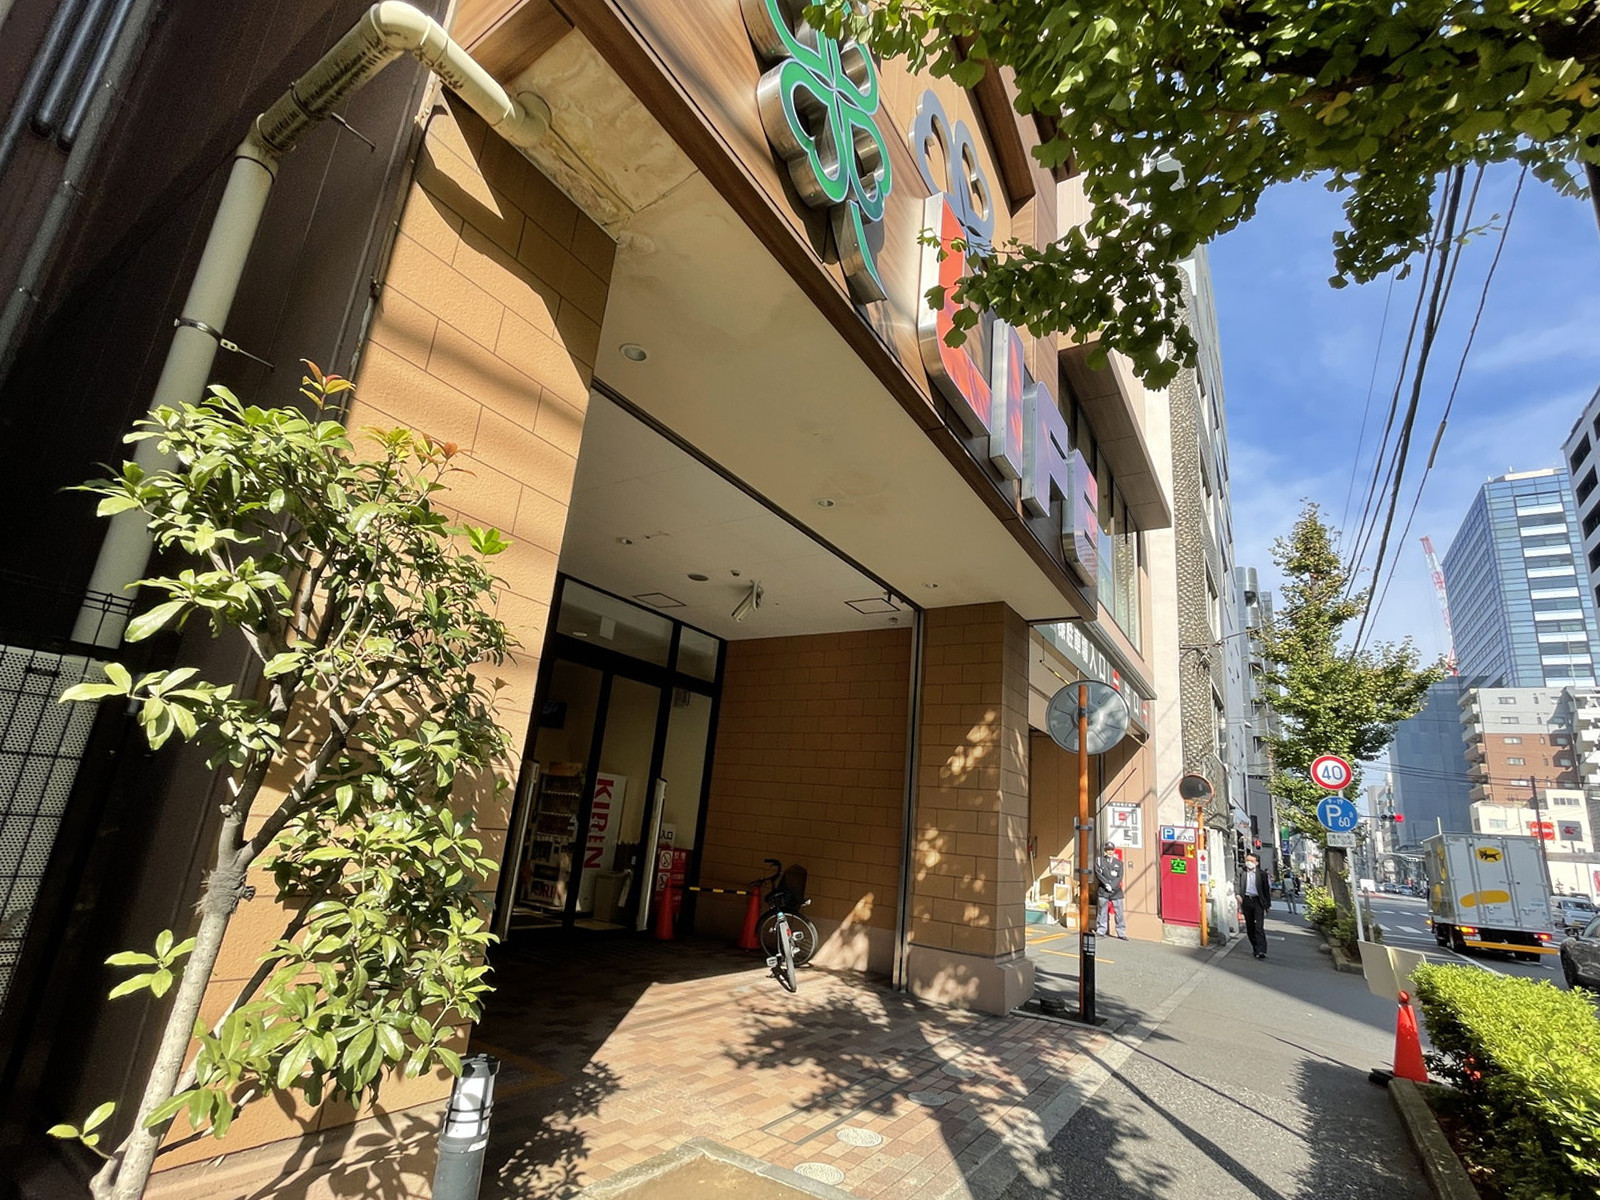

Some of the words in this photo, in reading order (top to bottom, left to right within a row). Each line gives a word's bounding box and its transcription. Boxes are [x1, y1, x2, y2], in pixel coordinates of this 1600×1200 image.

[918, 191, 1099, 588] LIFE
[1321, 765, 1344, 781] 40
[1325, 804, 1342, 827] P
[1170, 858, 1187, 874] 空
